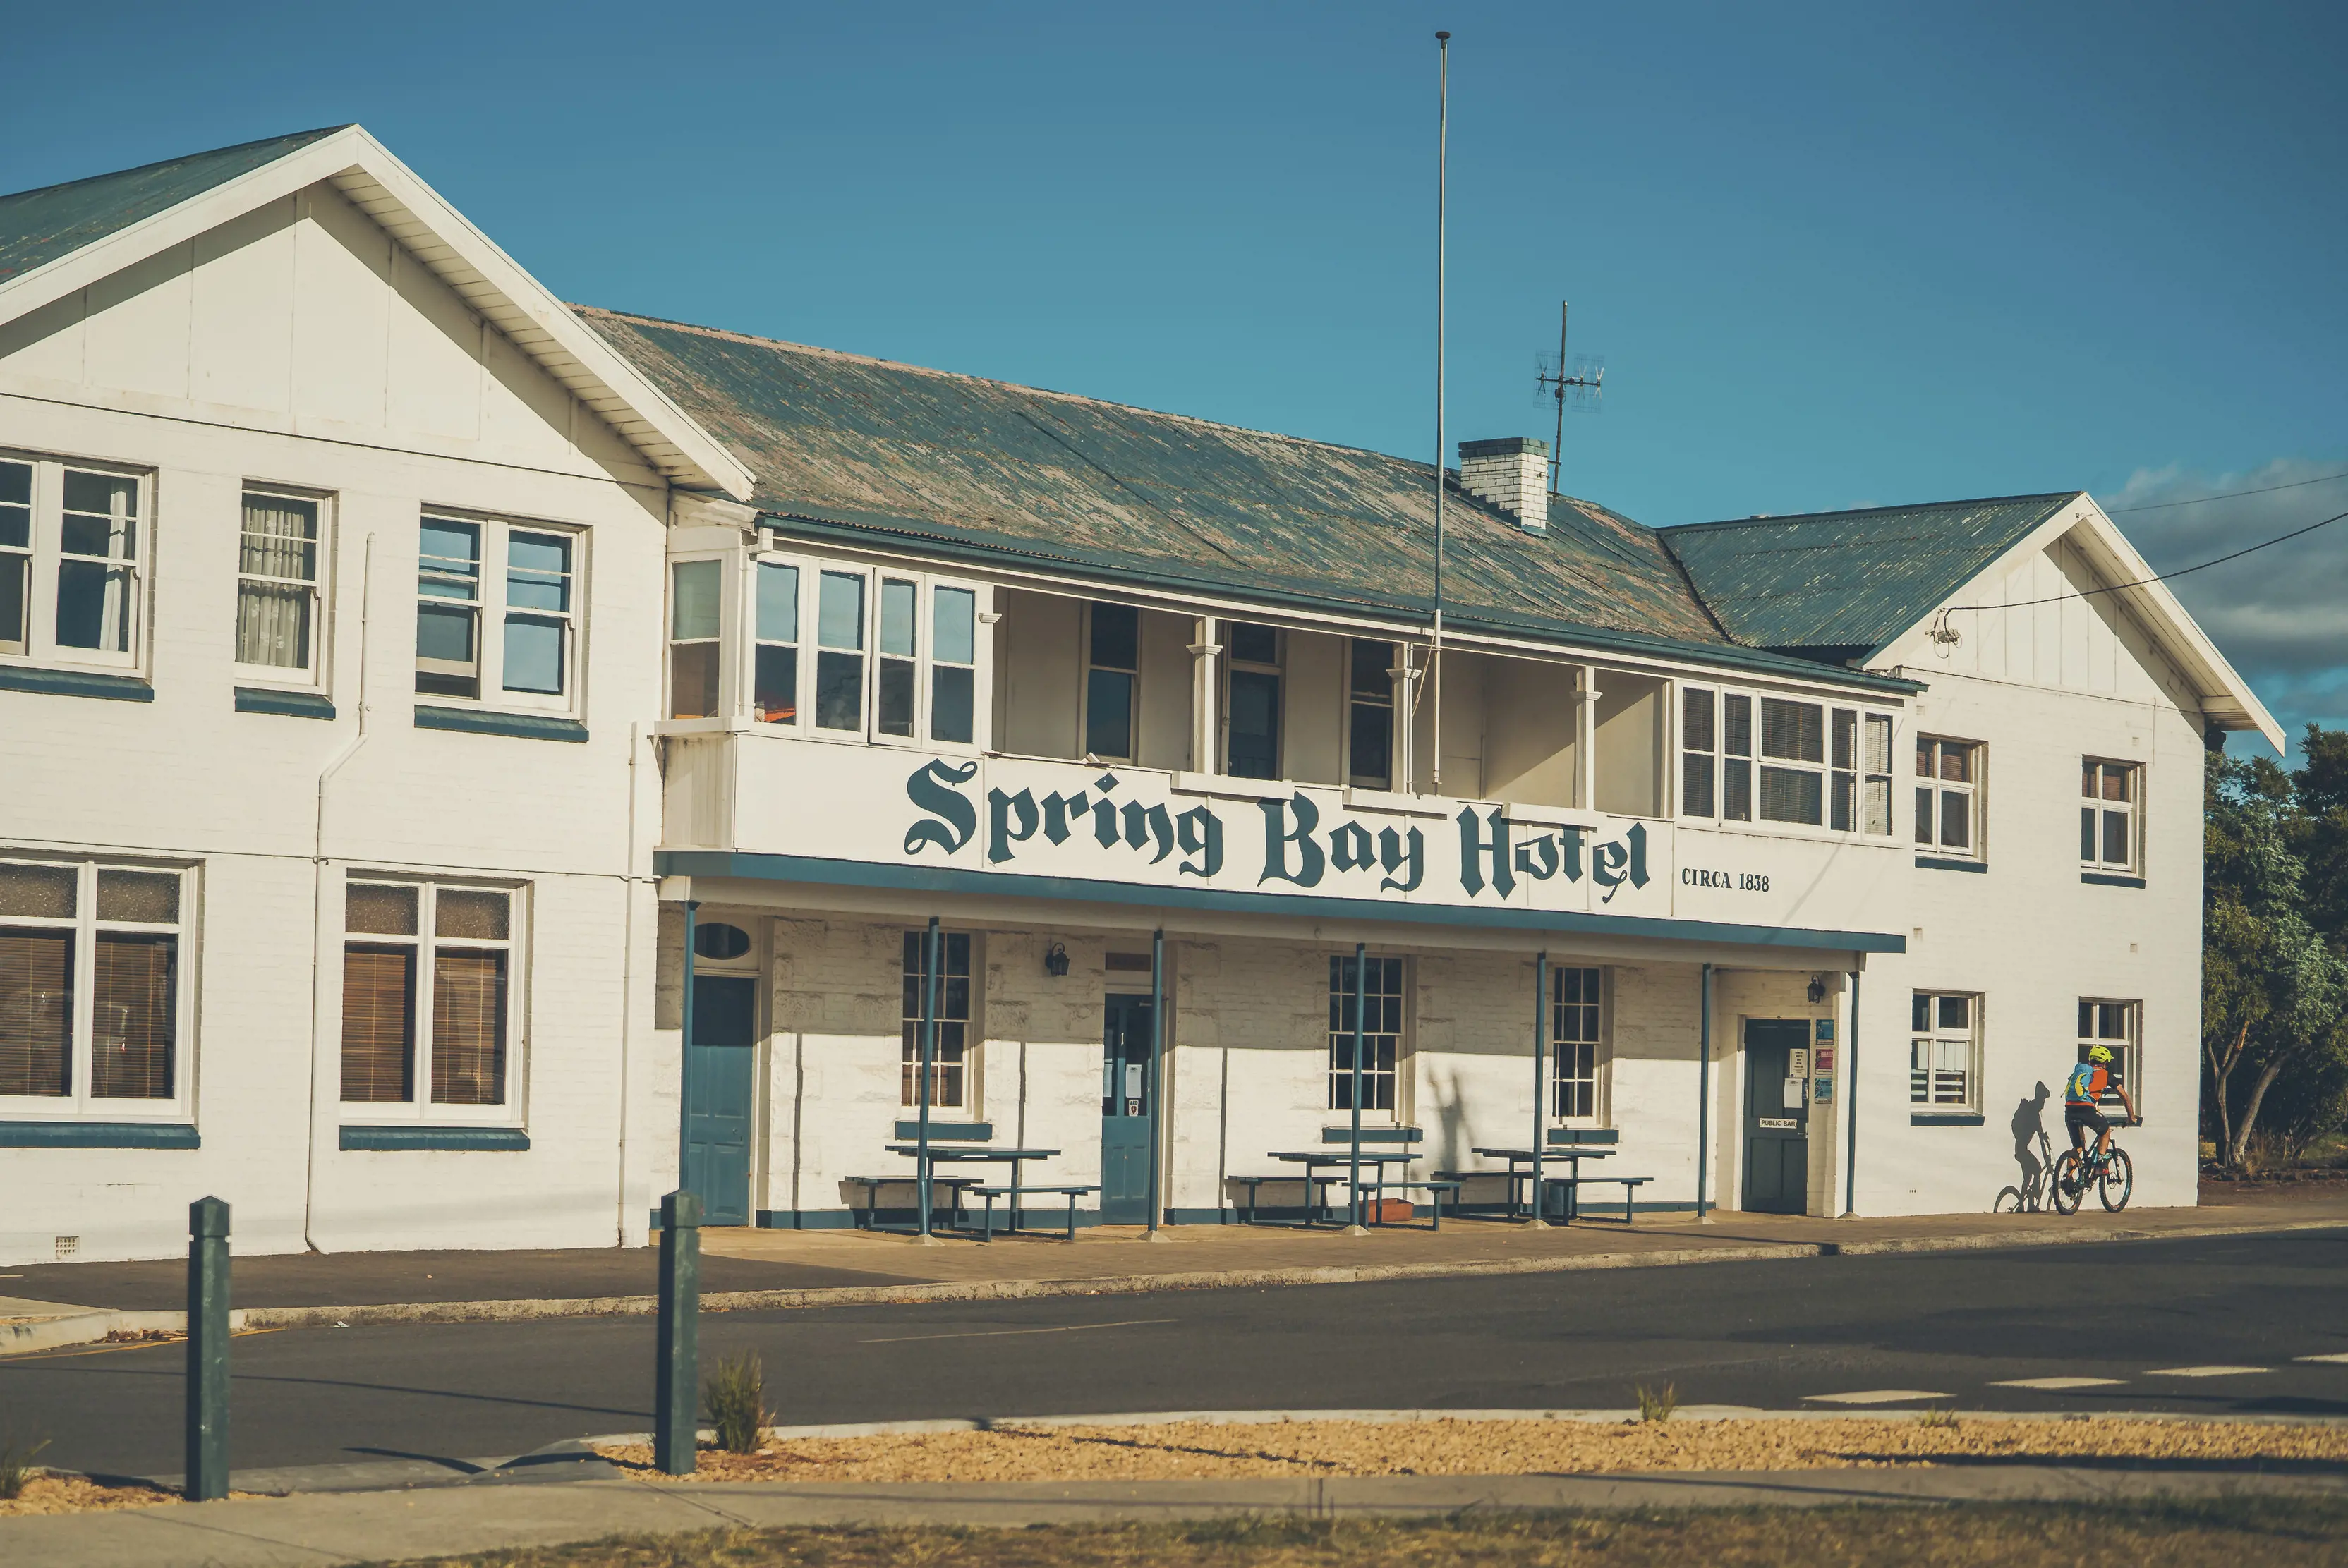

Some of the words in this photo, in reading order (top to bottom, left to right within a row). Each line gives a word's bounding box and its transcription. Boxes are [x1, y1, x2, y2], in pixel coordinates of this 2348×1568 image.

[904, 758, 1224, 878] Spring
[1257, 791, 1424, 893] Bay
[1456, 805, 1651, 904] Hotel
[1682, 868, 1732, 889] CIRCA
[1739, 873, 1769, 892] 1838
